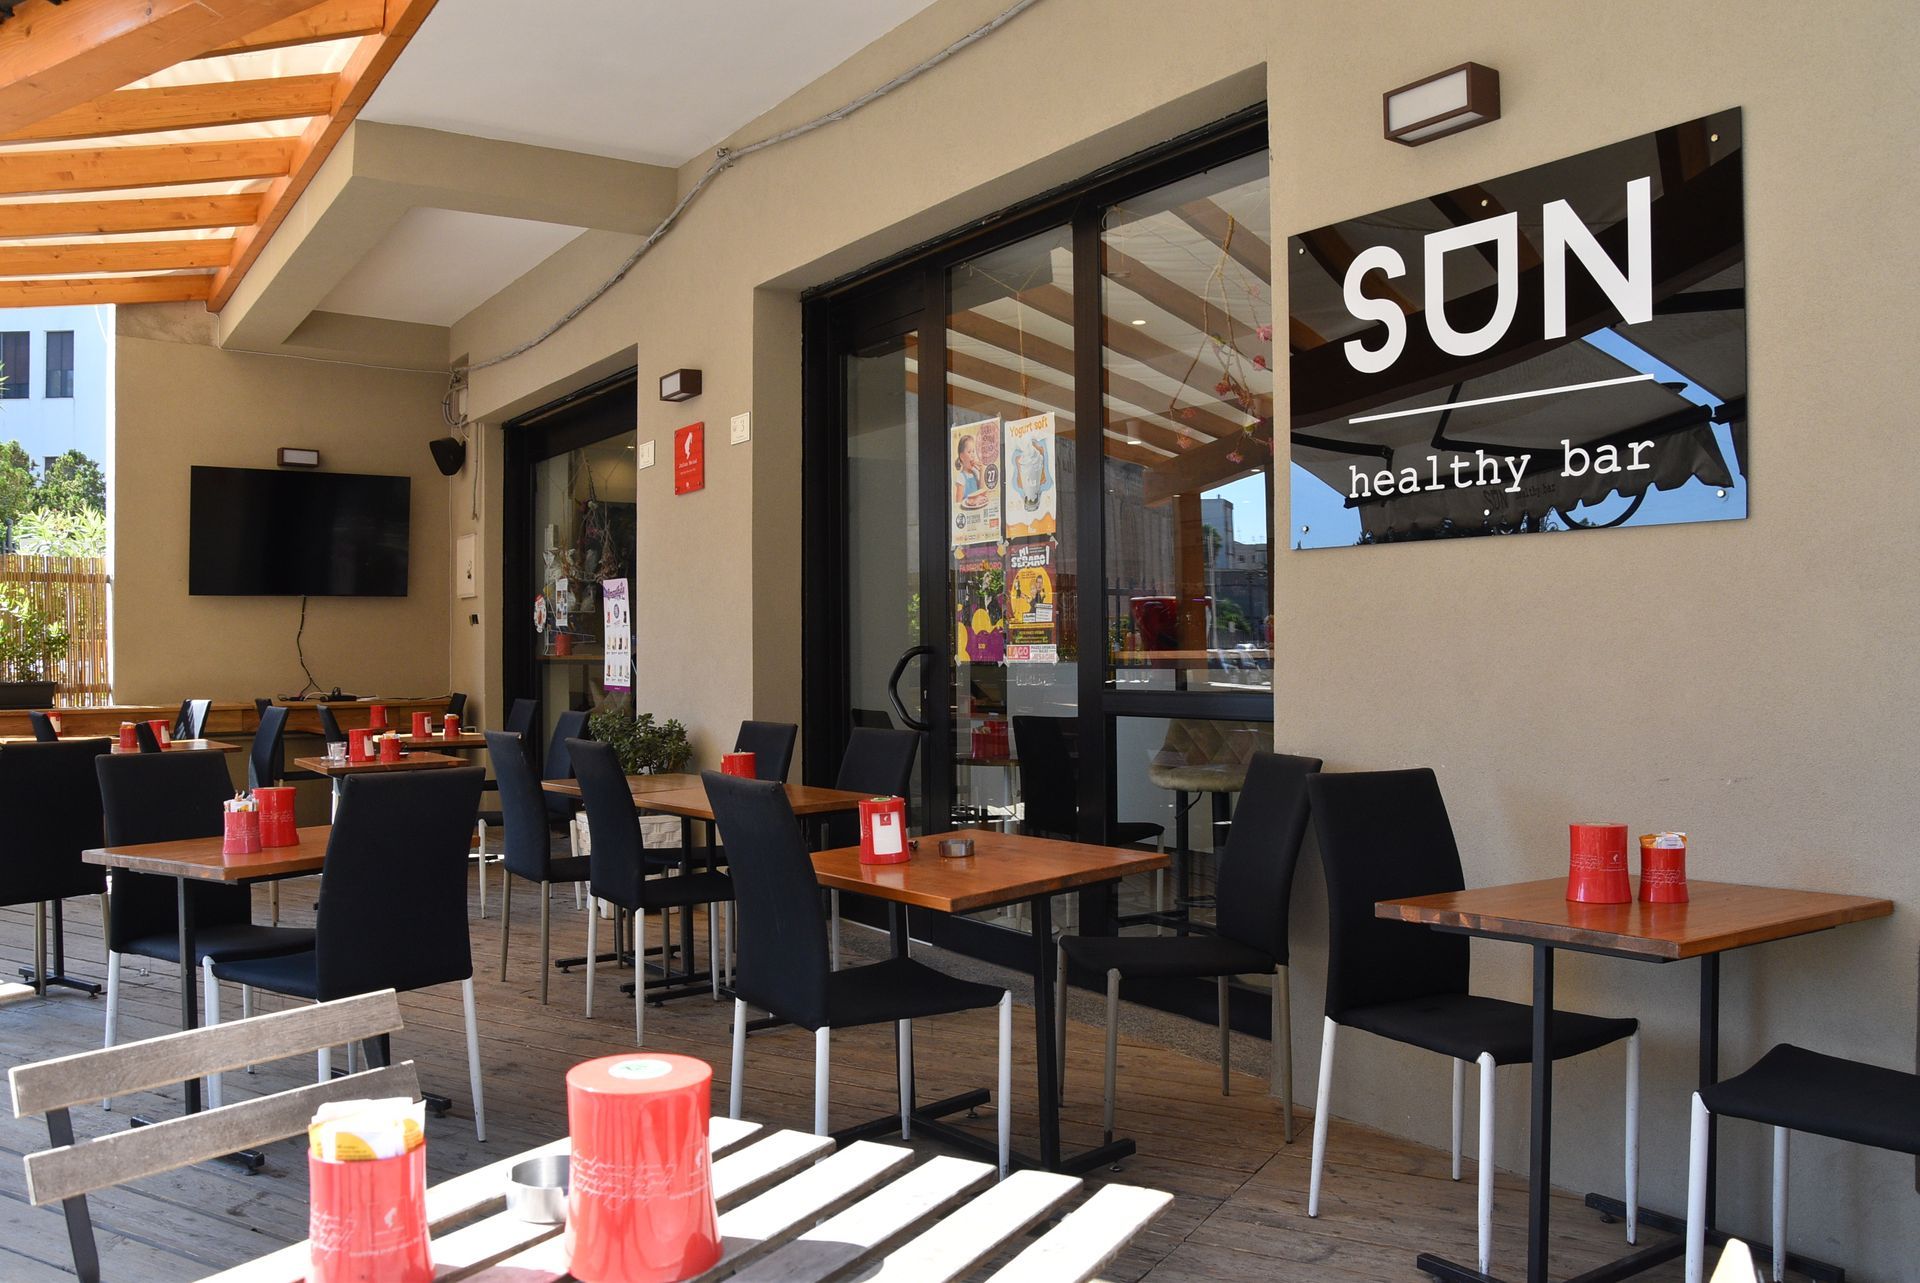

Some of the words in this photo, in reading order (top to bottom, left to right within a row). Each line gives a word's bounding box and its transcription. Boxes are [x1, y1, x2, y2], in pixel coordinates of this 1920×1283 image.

[1342, 175, 1653, 374] SUN
[1009, 422, 1033, 438] Yogurt
[1034, 415, 1048, 431] soft
[987, 470, 996, 482] 27
[1348, 448, 1531, 499] healthy
[1560, 437, 1656, 478] bar
[1018, 546, 1029, 557] MI
